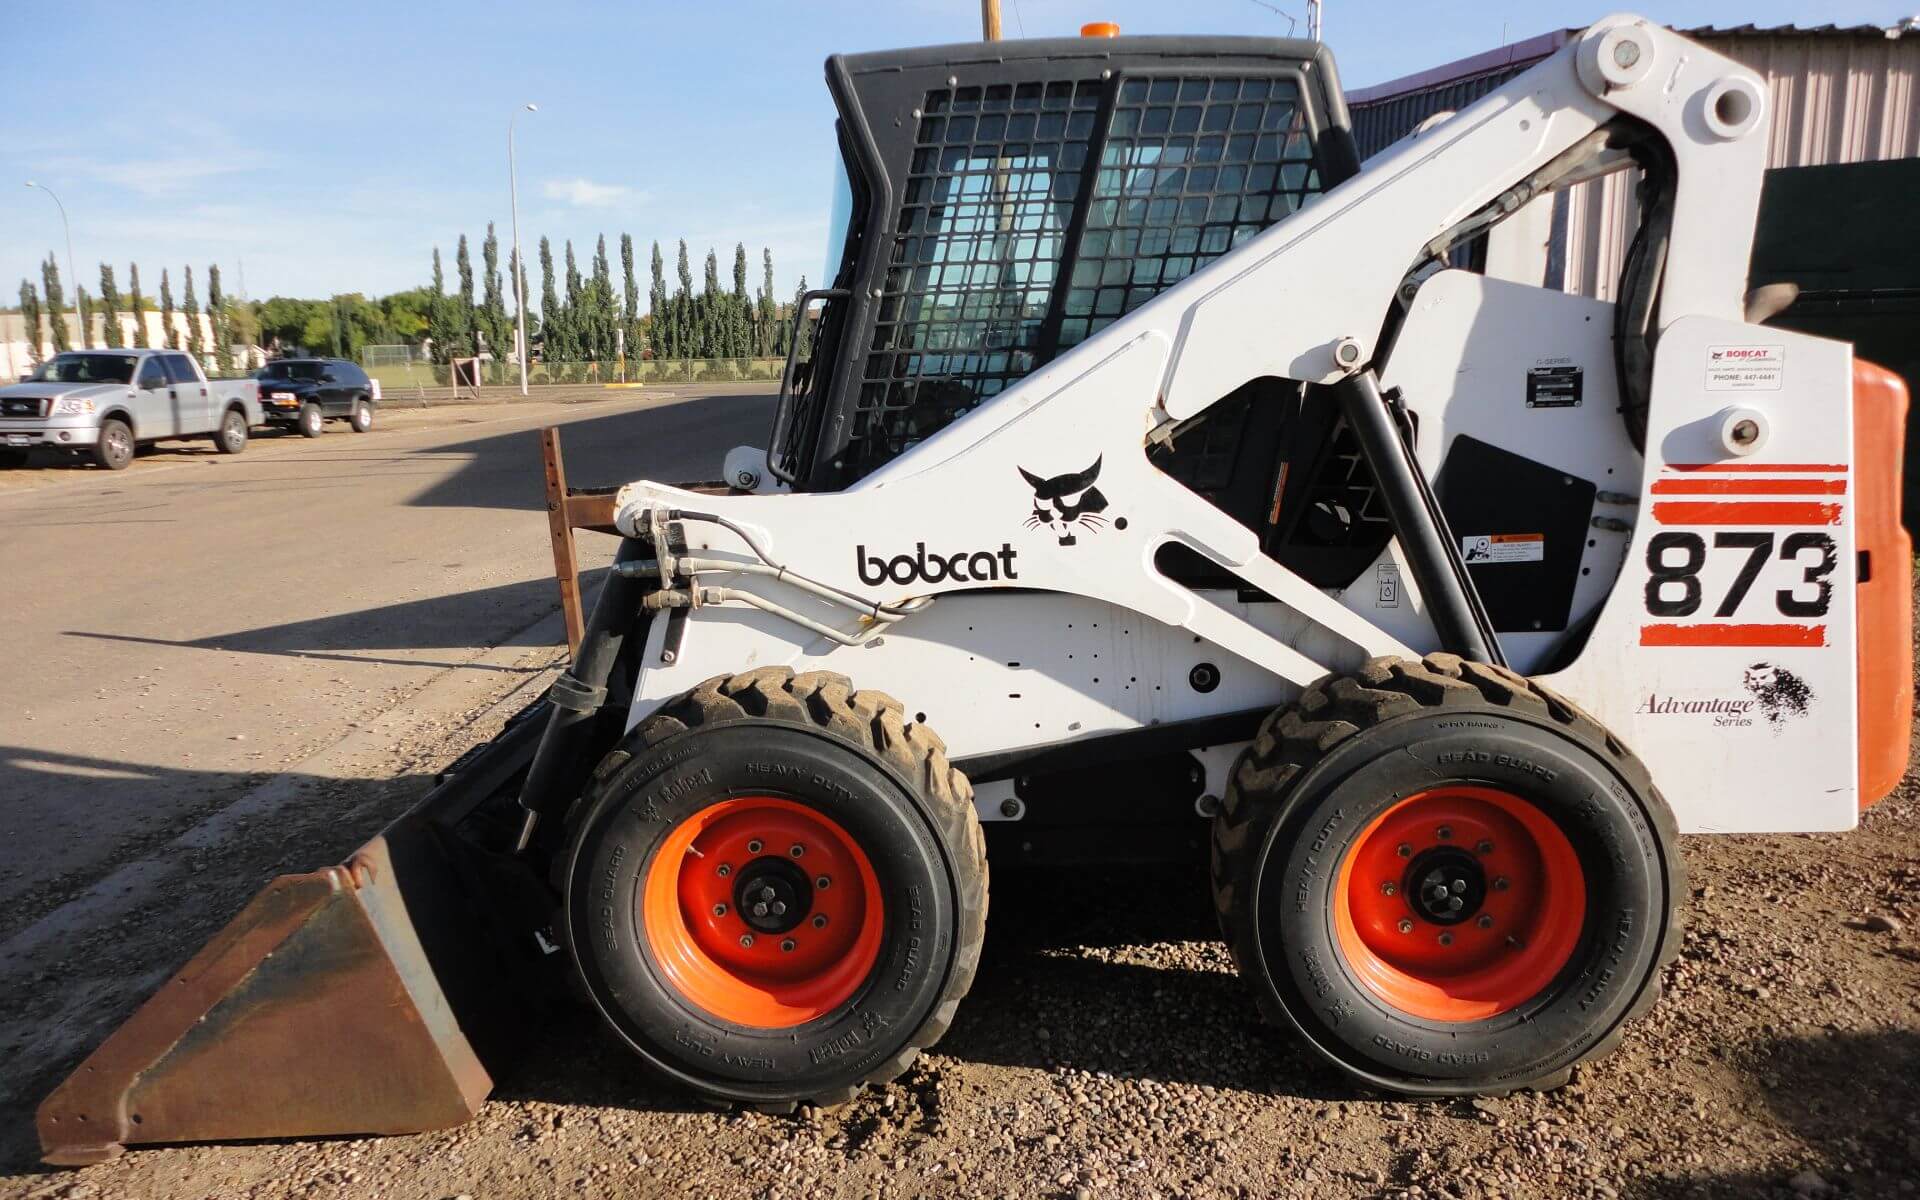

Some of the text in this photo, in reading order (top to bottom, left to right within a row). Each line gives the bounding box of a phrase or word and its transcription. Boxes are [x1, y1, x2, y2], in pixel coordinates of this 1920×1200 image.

[1726, 350, 1769, 358] BOBCAT
[856, 542, 1018, 586] bobcat
[1644, 531, 1838, 618] 873
[1635, 693, 1755, 718] Advantage
[1713, 715, 1753, 727] Series
